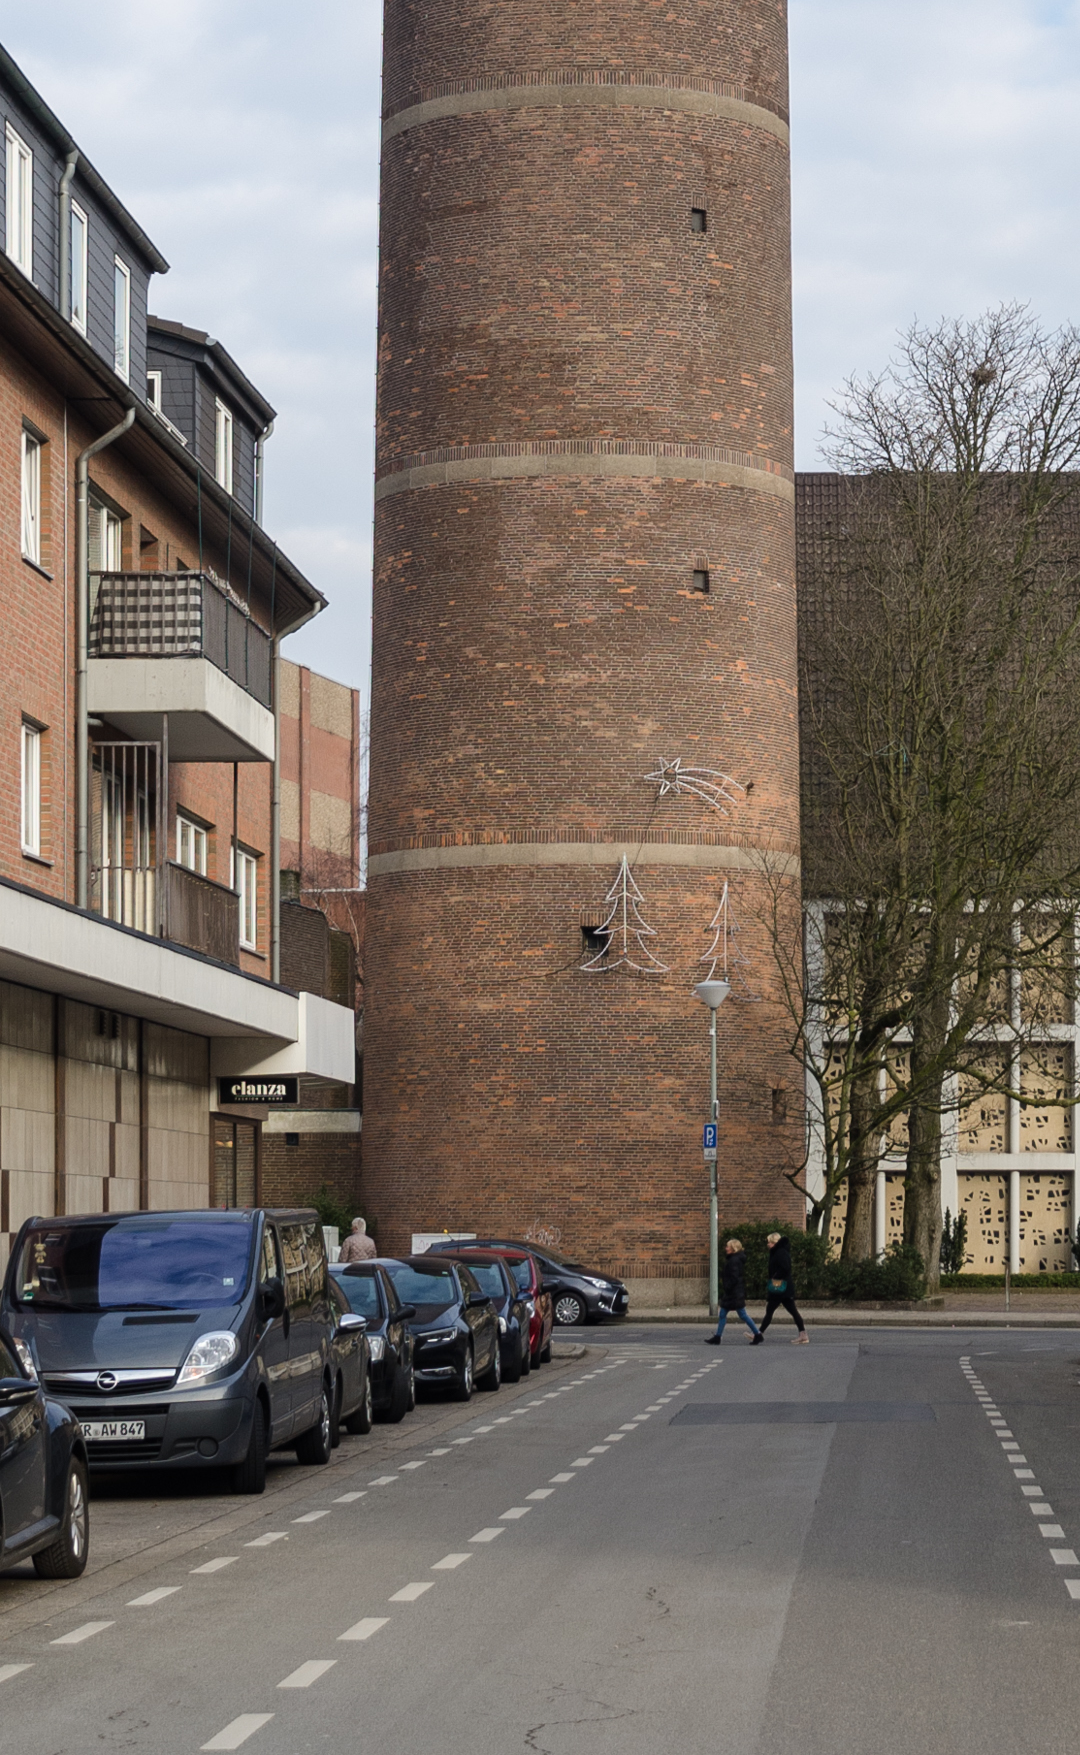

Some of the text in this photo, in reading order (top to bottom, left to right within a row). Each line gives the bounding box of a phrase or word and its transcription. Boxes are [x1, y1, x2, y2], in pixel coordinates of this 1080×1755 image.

[231, 1080, 286, 1096] elanza
[706, 1127, 714, 1145] P
[80, 1422, 144, 1436] R AW 847
